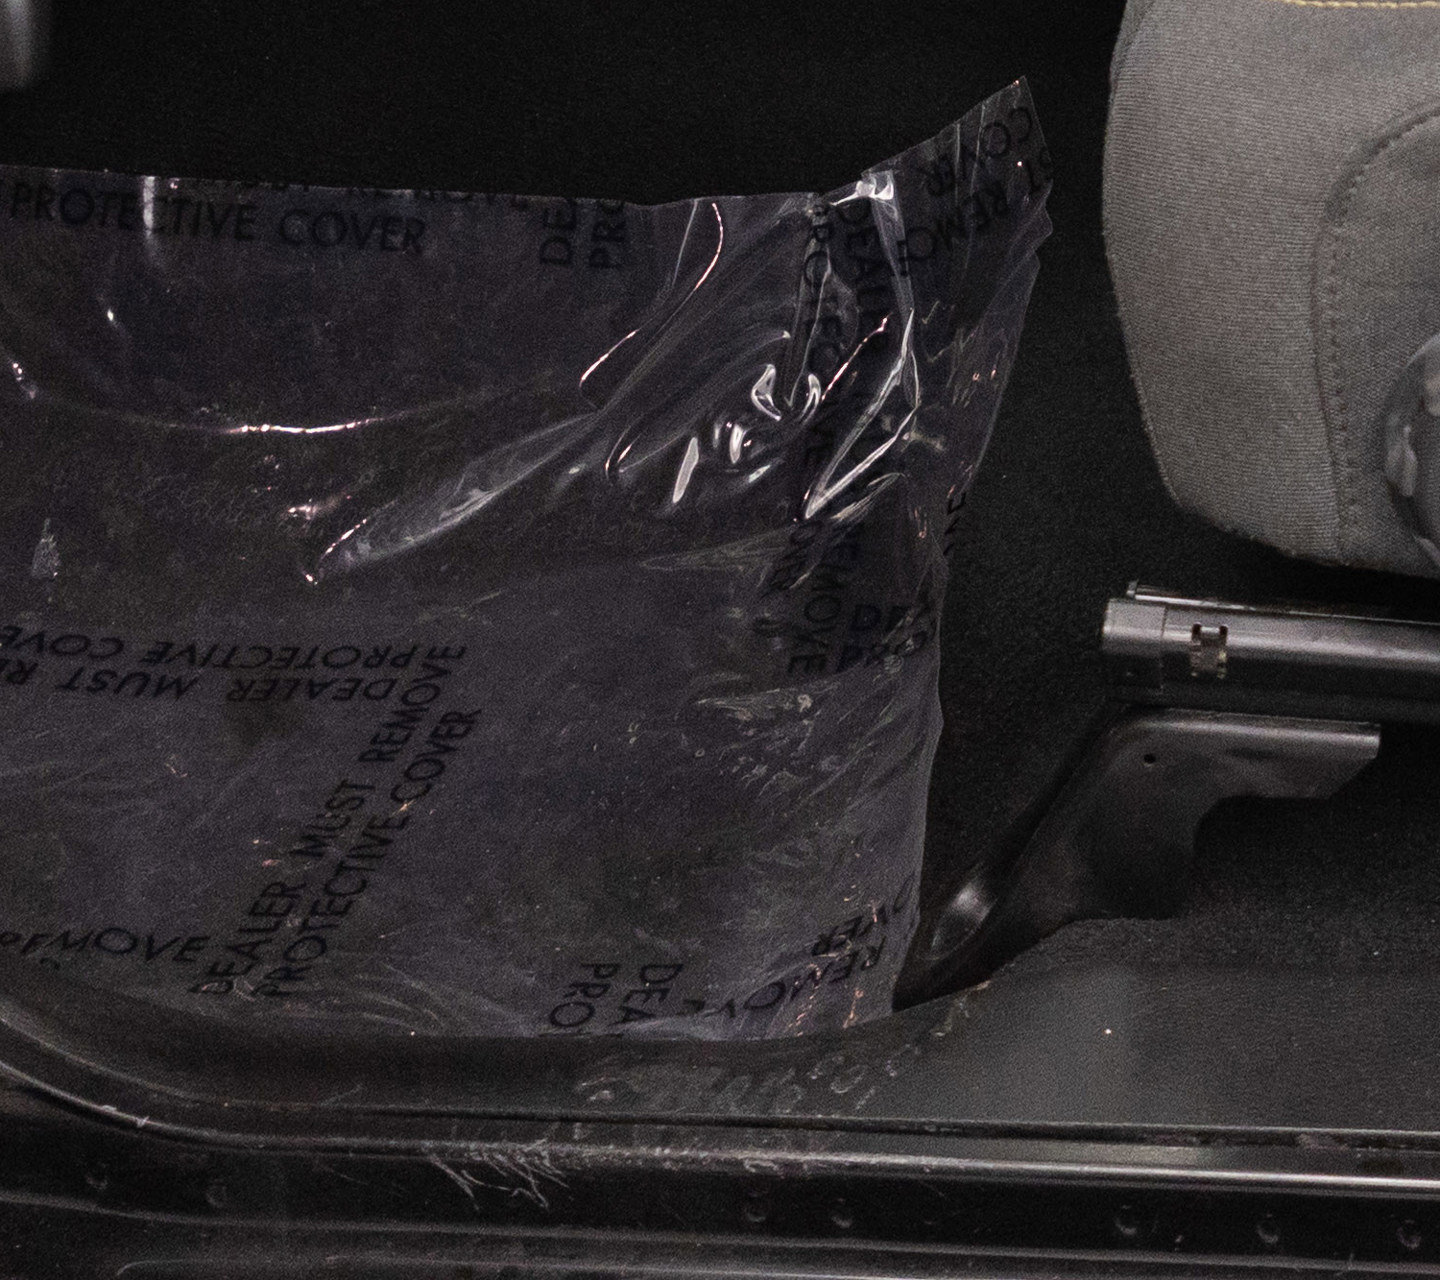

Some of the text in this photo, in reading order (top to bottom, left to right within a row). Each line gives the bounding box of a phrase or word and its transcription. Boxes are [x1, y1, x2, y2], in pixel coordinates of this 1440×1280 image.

[279, 209, 426, 254] COVER
[141, 640, 417, 670] PROTECTIVE
[56, 667, 199, 700] MUST
[226, 677, 397, 702] DEALER
[188, 645, 467, 996] DEALER MUST REMOVE
[254, 709, 482, 998] PROTECTIVE COVER
